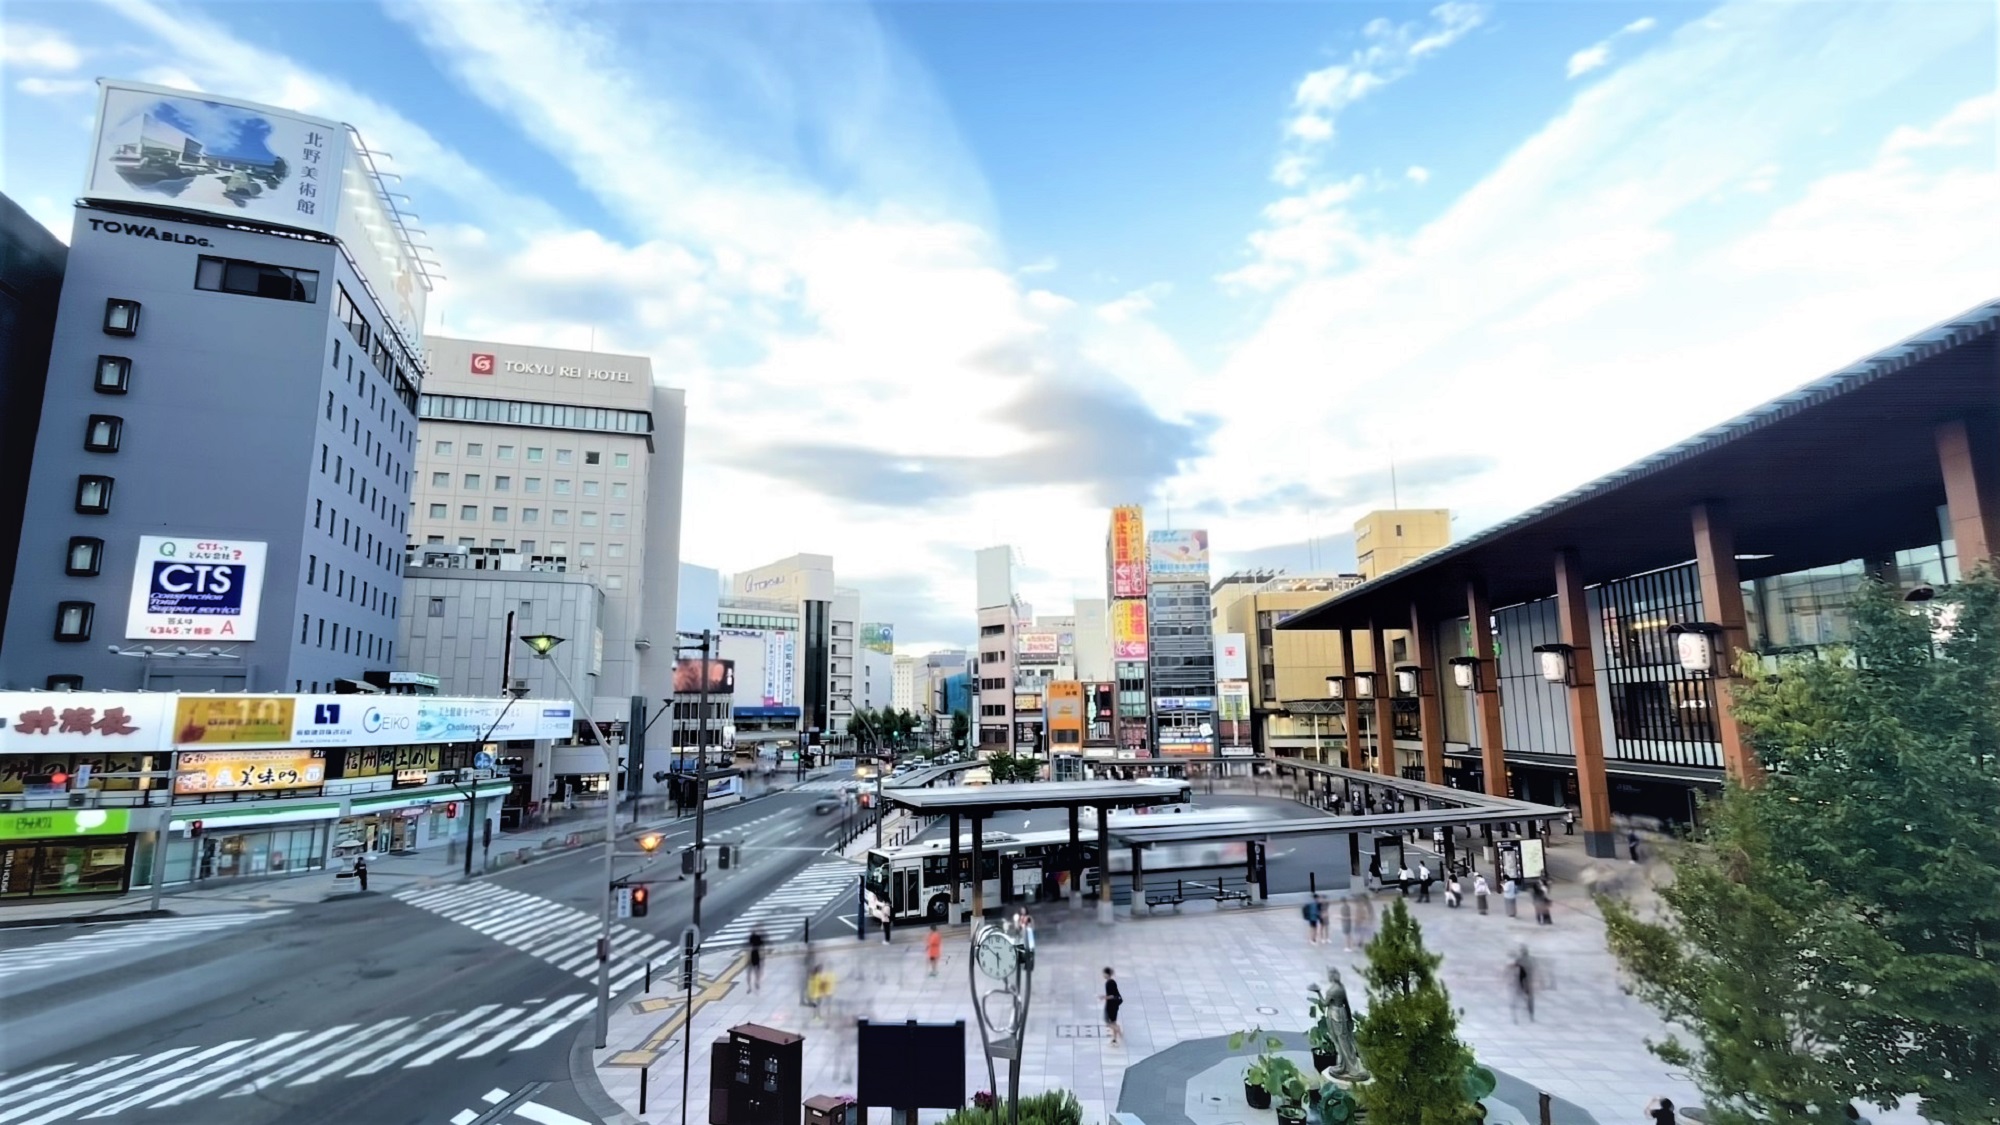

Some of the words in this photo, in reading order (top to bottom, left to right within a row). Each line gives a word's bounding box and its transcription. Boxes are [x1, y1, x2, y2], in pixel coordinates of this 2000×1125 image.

[297, 131, 323, 216] 北野美術館
[88, 218, 160, 241] TOWA
[160, 231, 215, 248] BLDG.
[504, 360, 554, 376] TOKYU
[559, 366, 581, 378] REI
[587, 369, 633, 384] HOTEL
[159, 541, 177, 557] Q
[158, 564, 233, 594] CTS
[149, 598, 180, 606] Total
[150, 592, 224, 601] Construction
[149, 605, 196, 615] Support
[197, 606, 241, 615] service
[219, 620, 235, 635] A
[719, 629, 763, 639] TOKYU
[345, 748, 436, 771] 信州郷土めし
